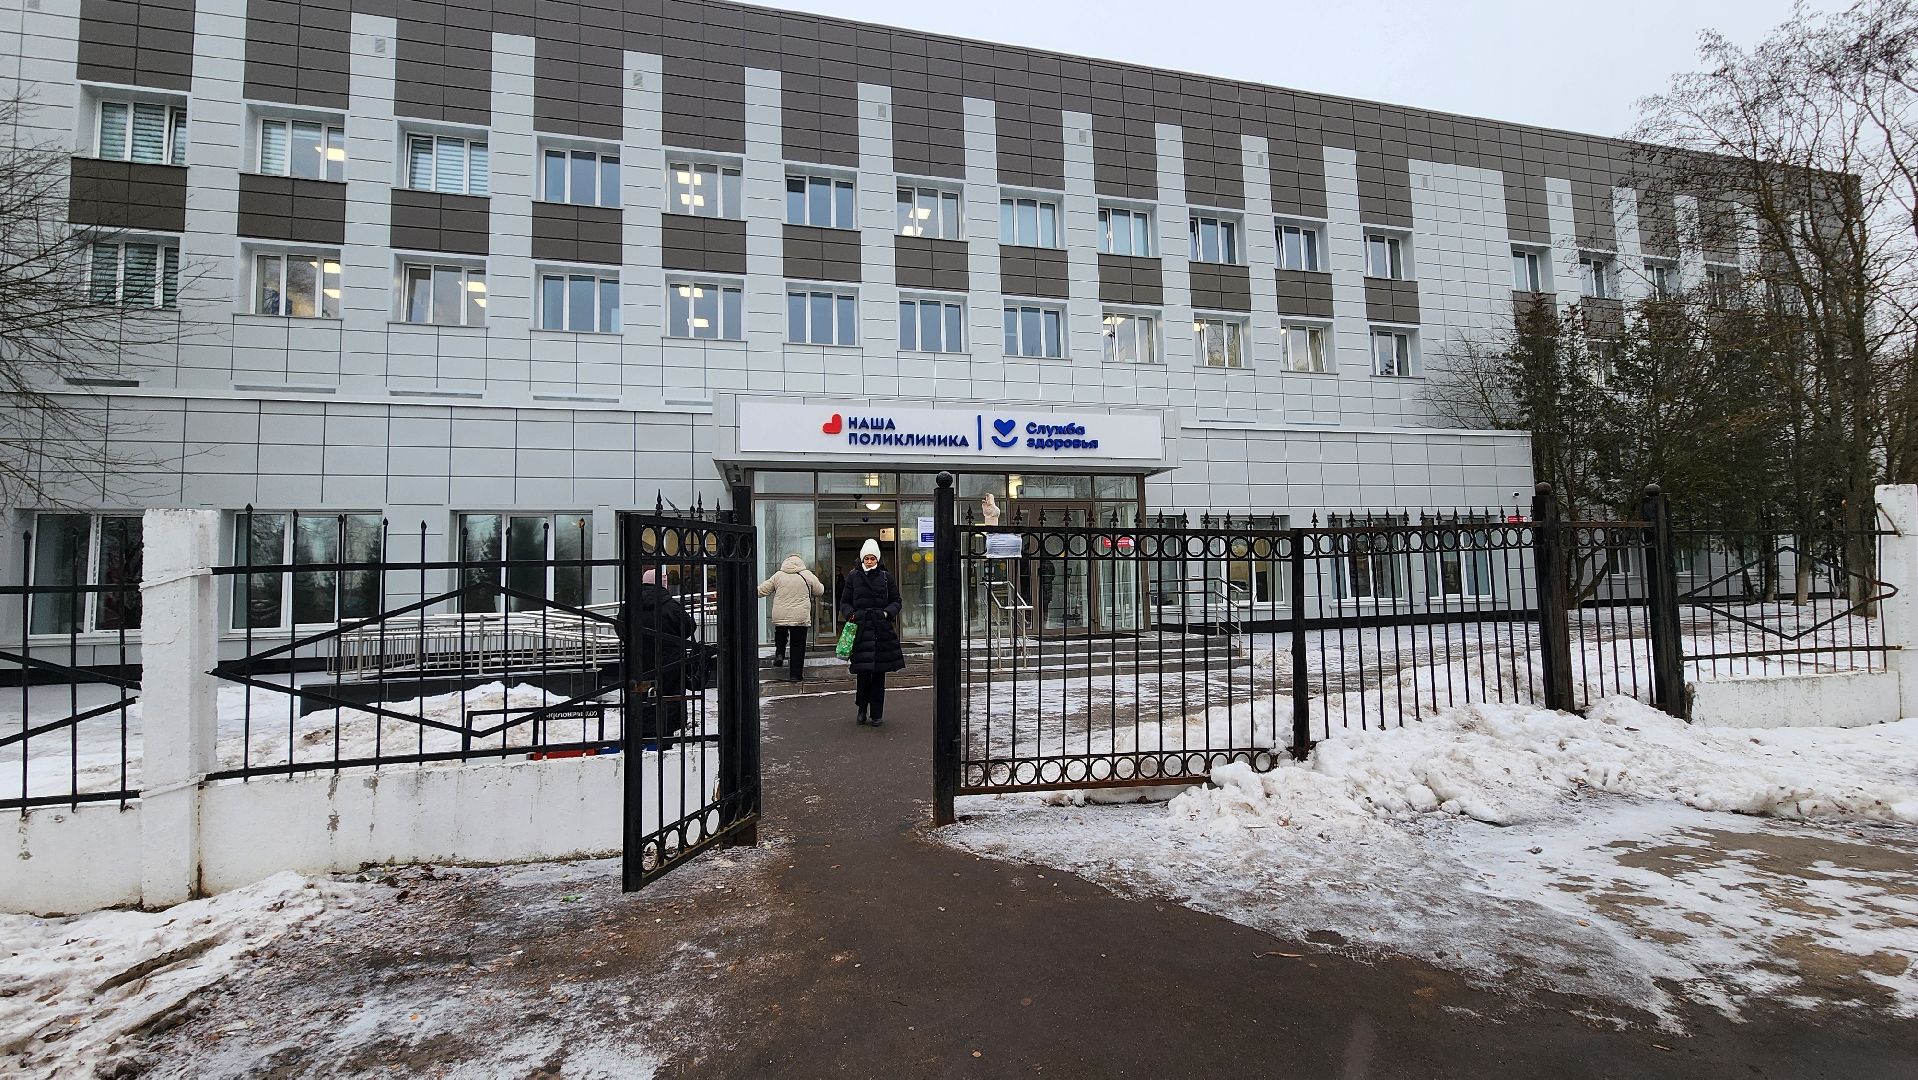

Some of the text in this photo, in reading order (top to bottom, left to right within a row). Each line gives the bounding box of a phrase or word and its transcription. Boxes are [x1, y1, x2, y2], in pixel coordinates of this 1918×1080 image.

[848, 416, 896, 430] НАША
[1026, 422, 1086, 437] Служба
[848, 433, 970, 447] ПОЛИКЛИНИКА
[1026, 437, 1099, 450] здоровья
